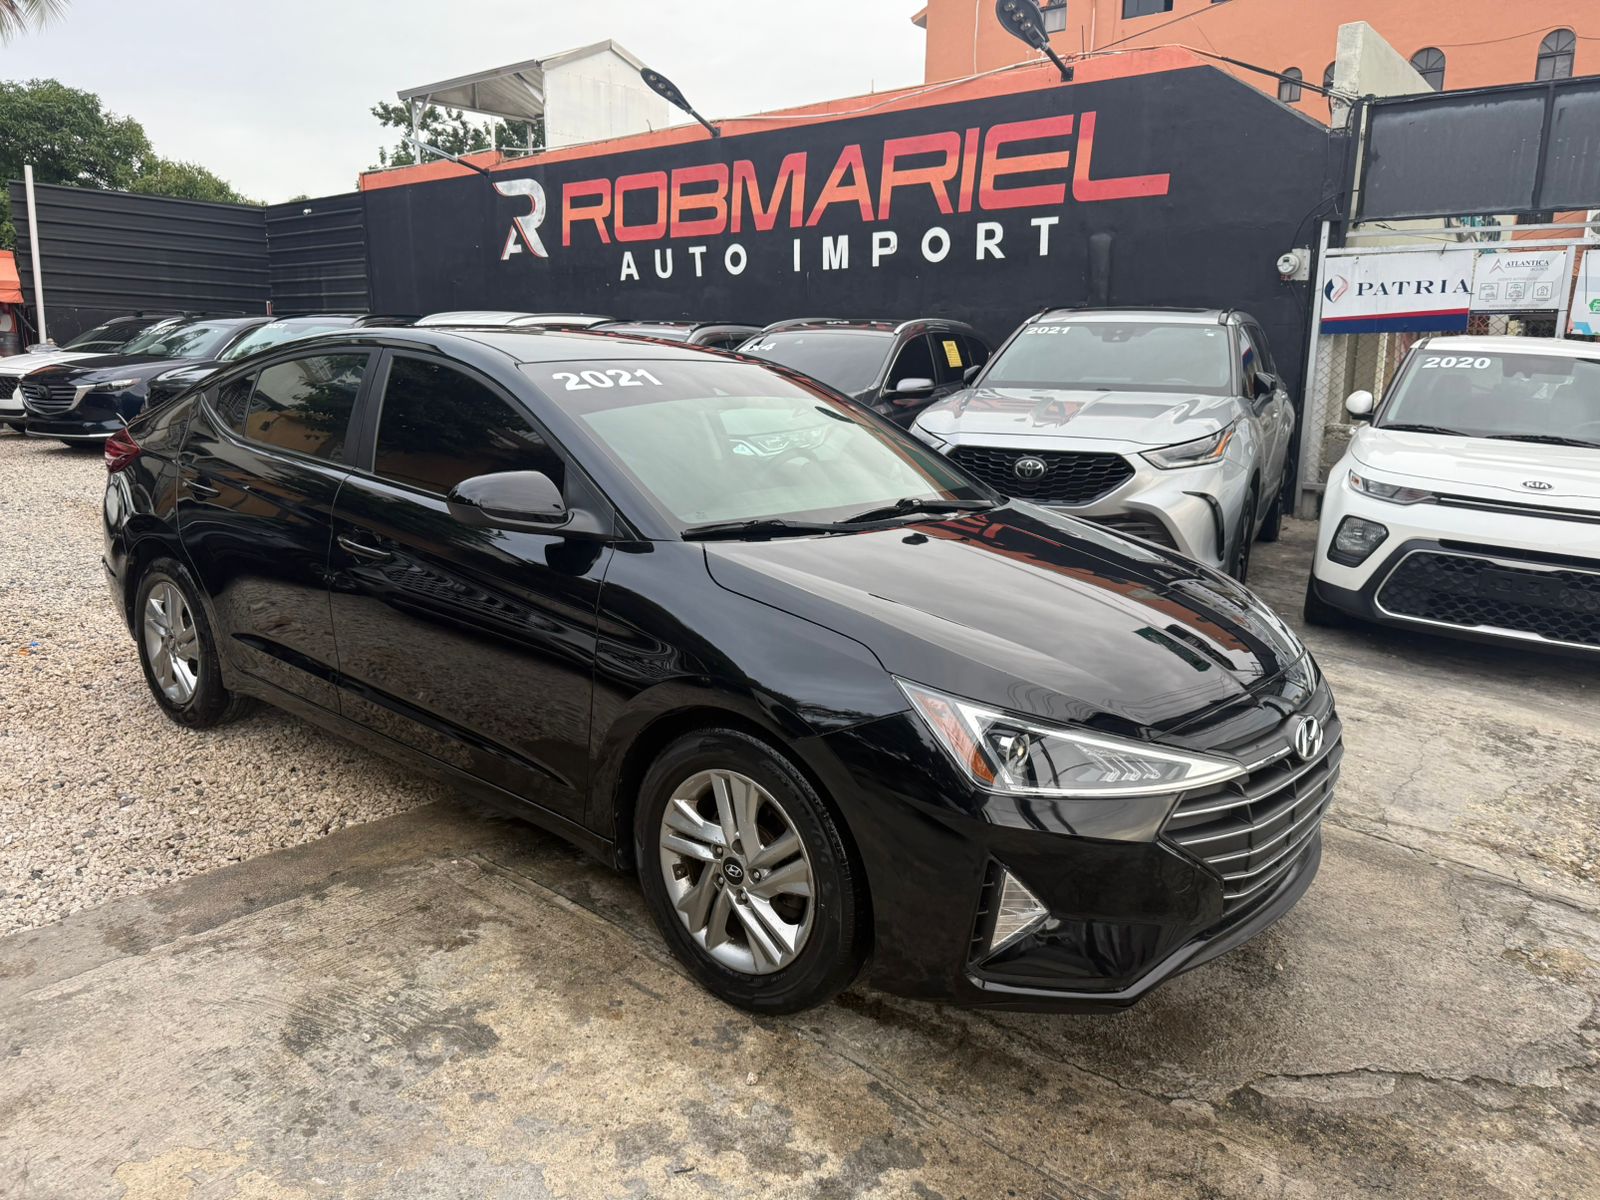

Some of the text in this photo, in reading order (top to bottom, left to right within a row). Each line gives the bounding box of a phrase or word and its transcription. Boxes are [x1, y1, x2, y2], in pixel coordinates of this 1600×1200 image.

[562, 111, 1170, 246] ROBMARIEL
[620, 216, 1059, 281] AUTO IMPORT
[1505, 259, 1550, 268] ATLANTICA
[1356, 278, 1470, 296] PATRIA
[1025, 326, 1071, 335] 2021
[1422, 356, 1492, 369] 2020
[552, 368, 664, 391] 2021
